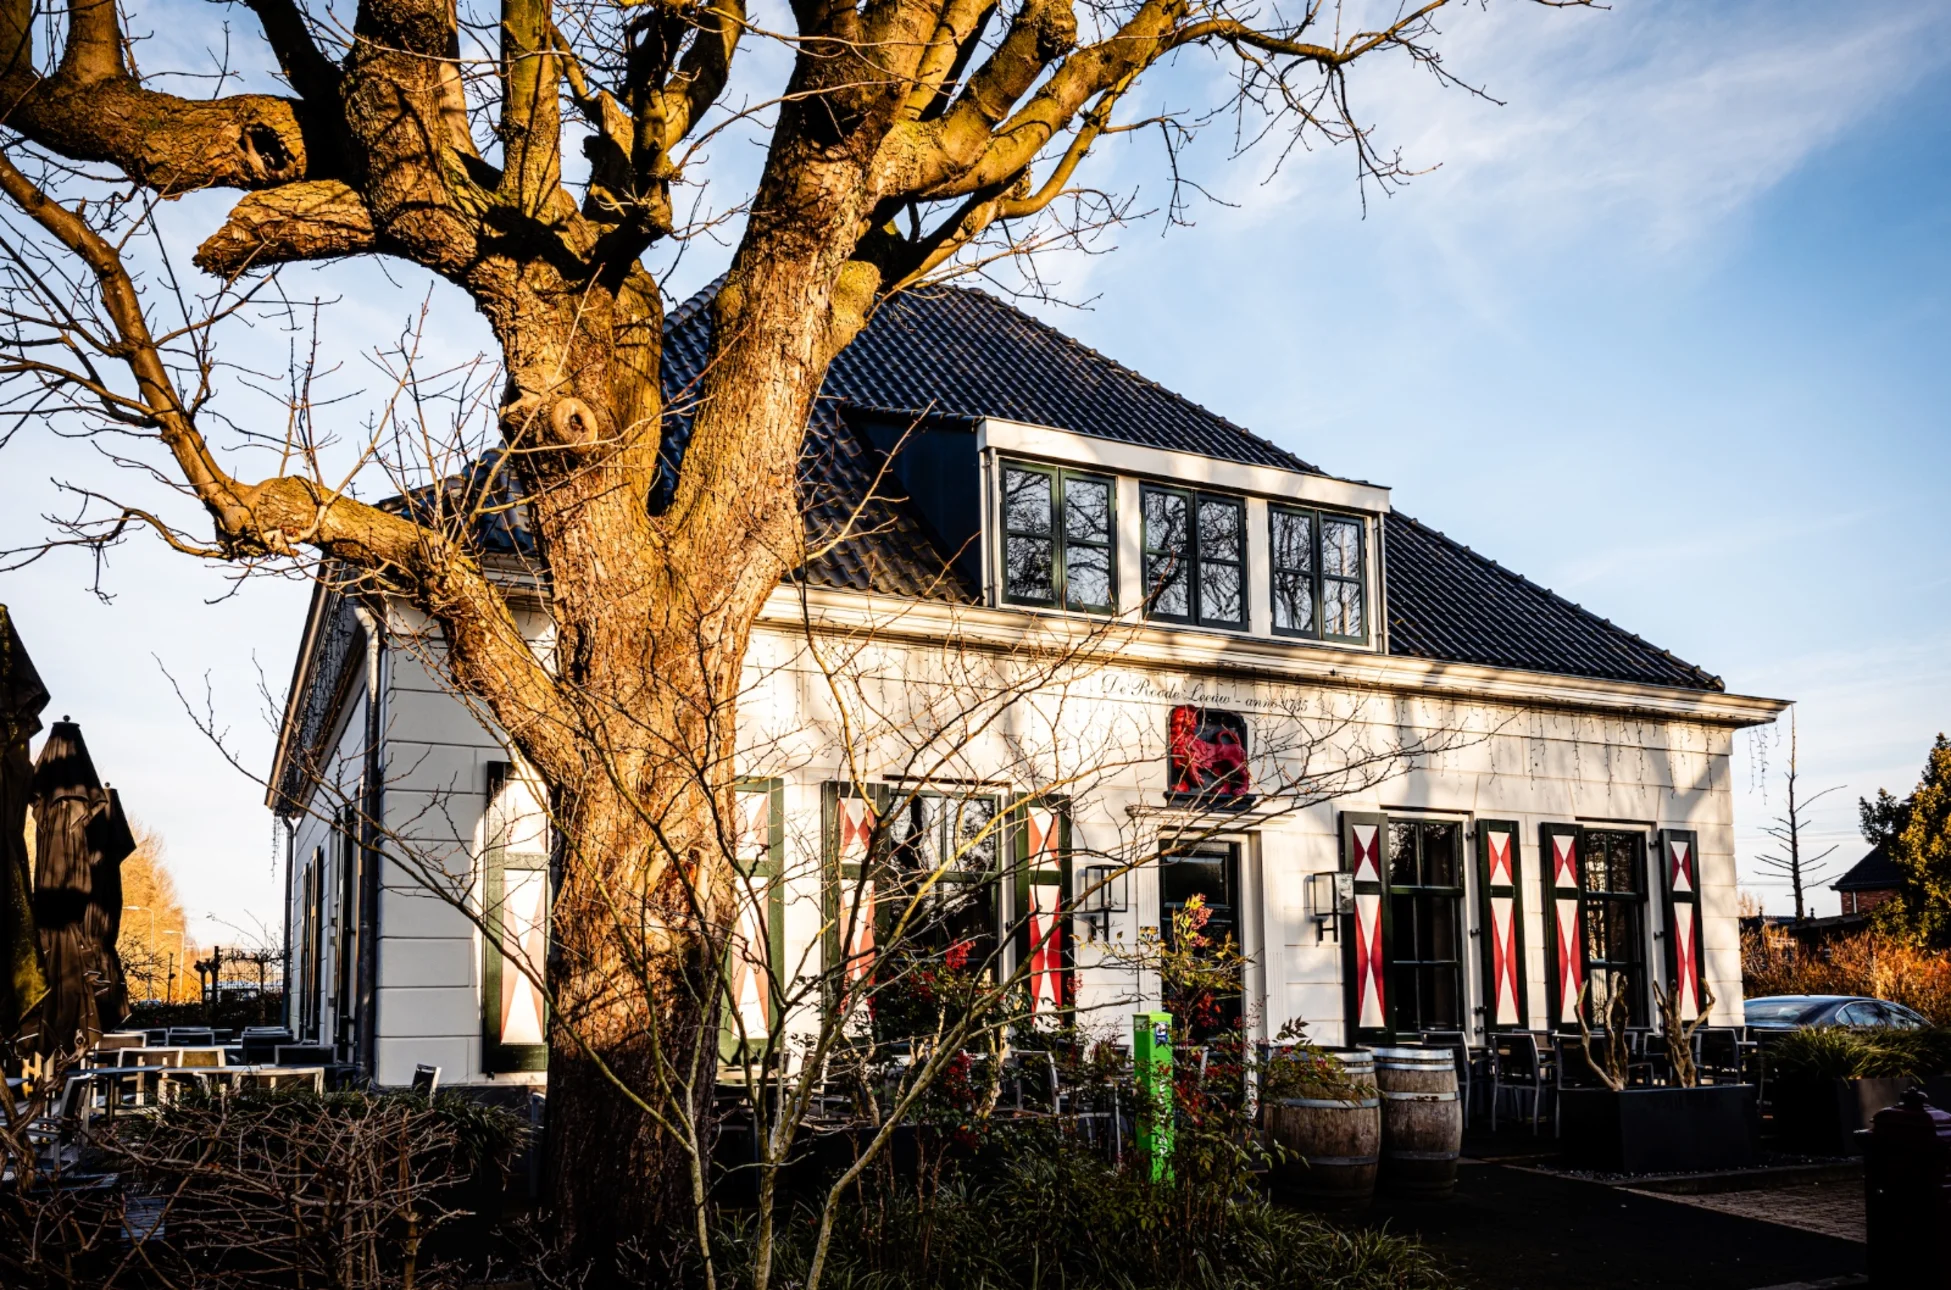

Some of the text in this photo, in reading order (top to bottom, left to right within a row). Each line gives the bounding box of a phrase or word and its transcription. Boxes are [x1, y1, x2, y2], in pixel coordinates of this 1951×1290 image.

[1101, 673, 1126, 695] De
[1130, 678, 1180, 699] Roode
[1187, 682, 1230, 705] Leeuw
